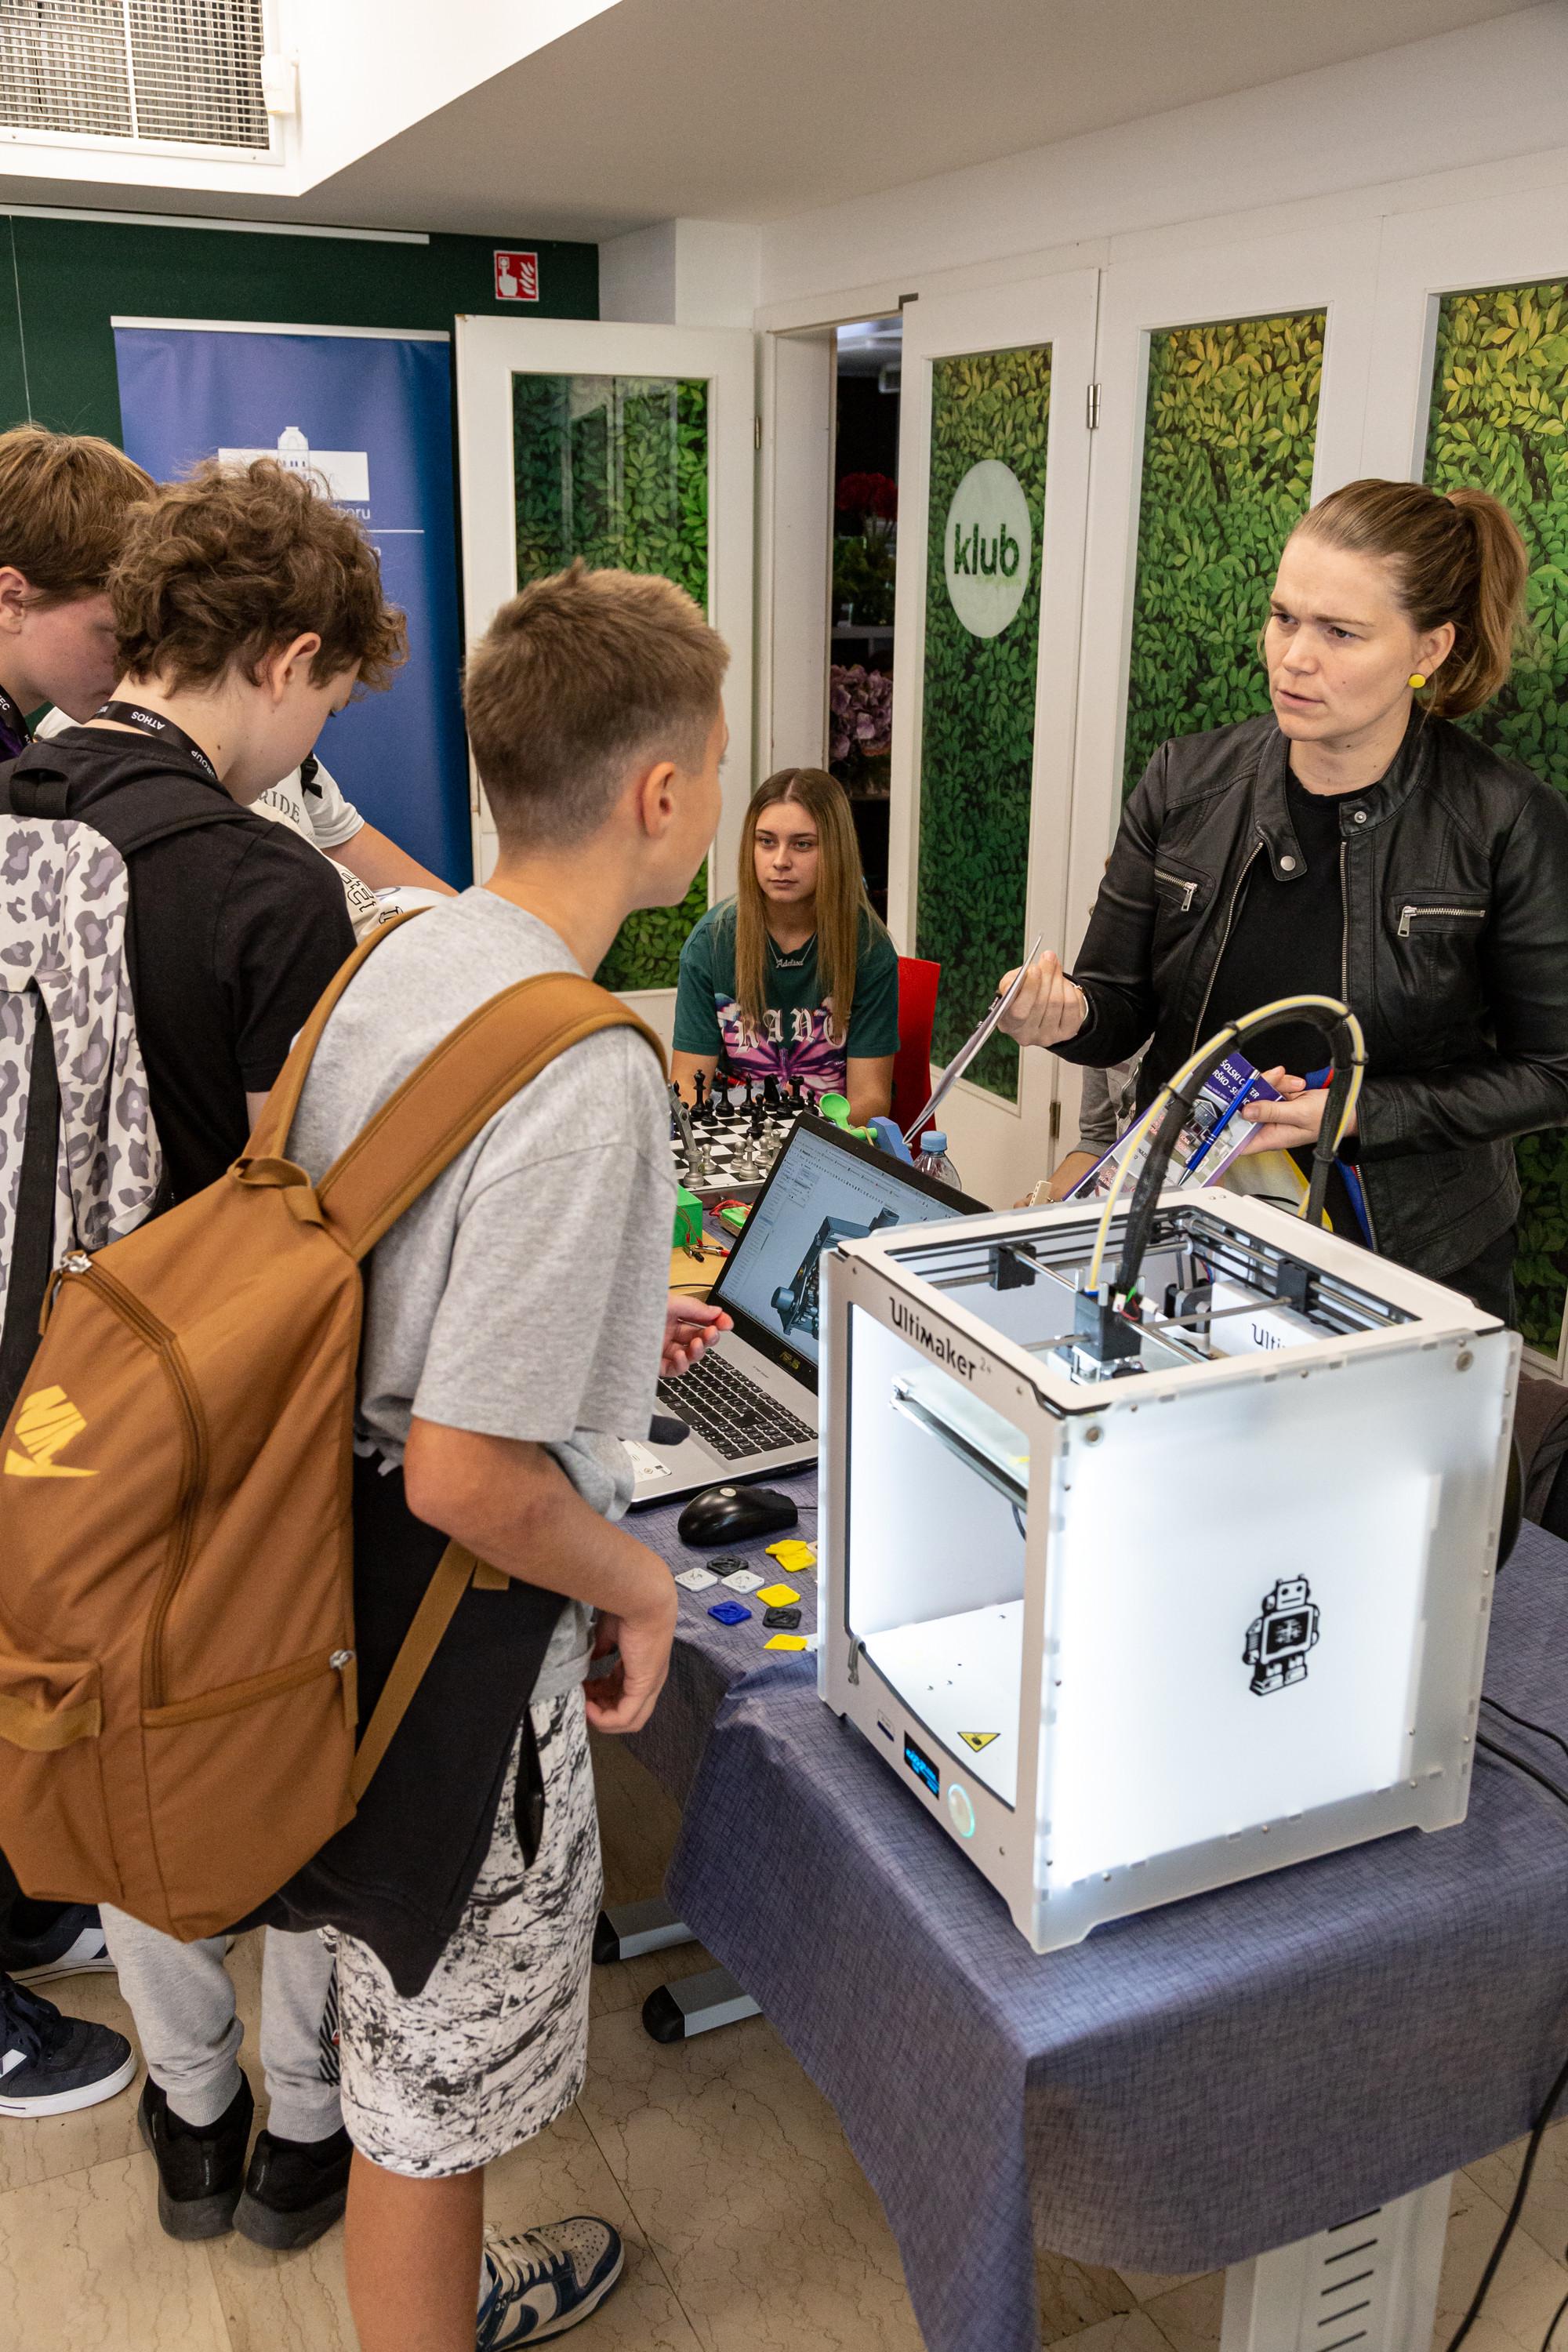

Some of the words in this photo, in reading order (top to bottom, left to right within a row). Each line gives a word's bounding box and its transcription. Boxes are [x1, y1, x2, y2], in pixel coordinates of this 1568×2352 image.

[954, 523, 1020, 577] klub
[131, 711, 165, 730] ATHOS
[1251, 1323, 1285, 1350] Ulti
